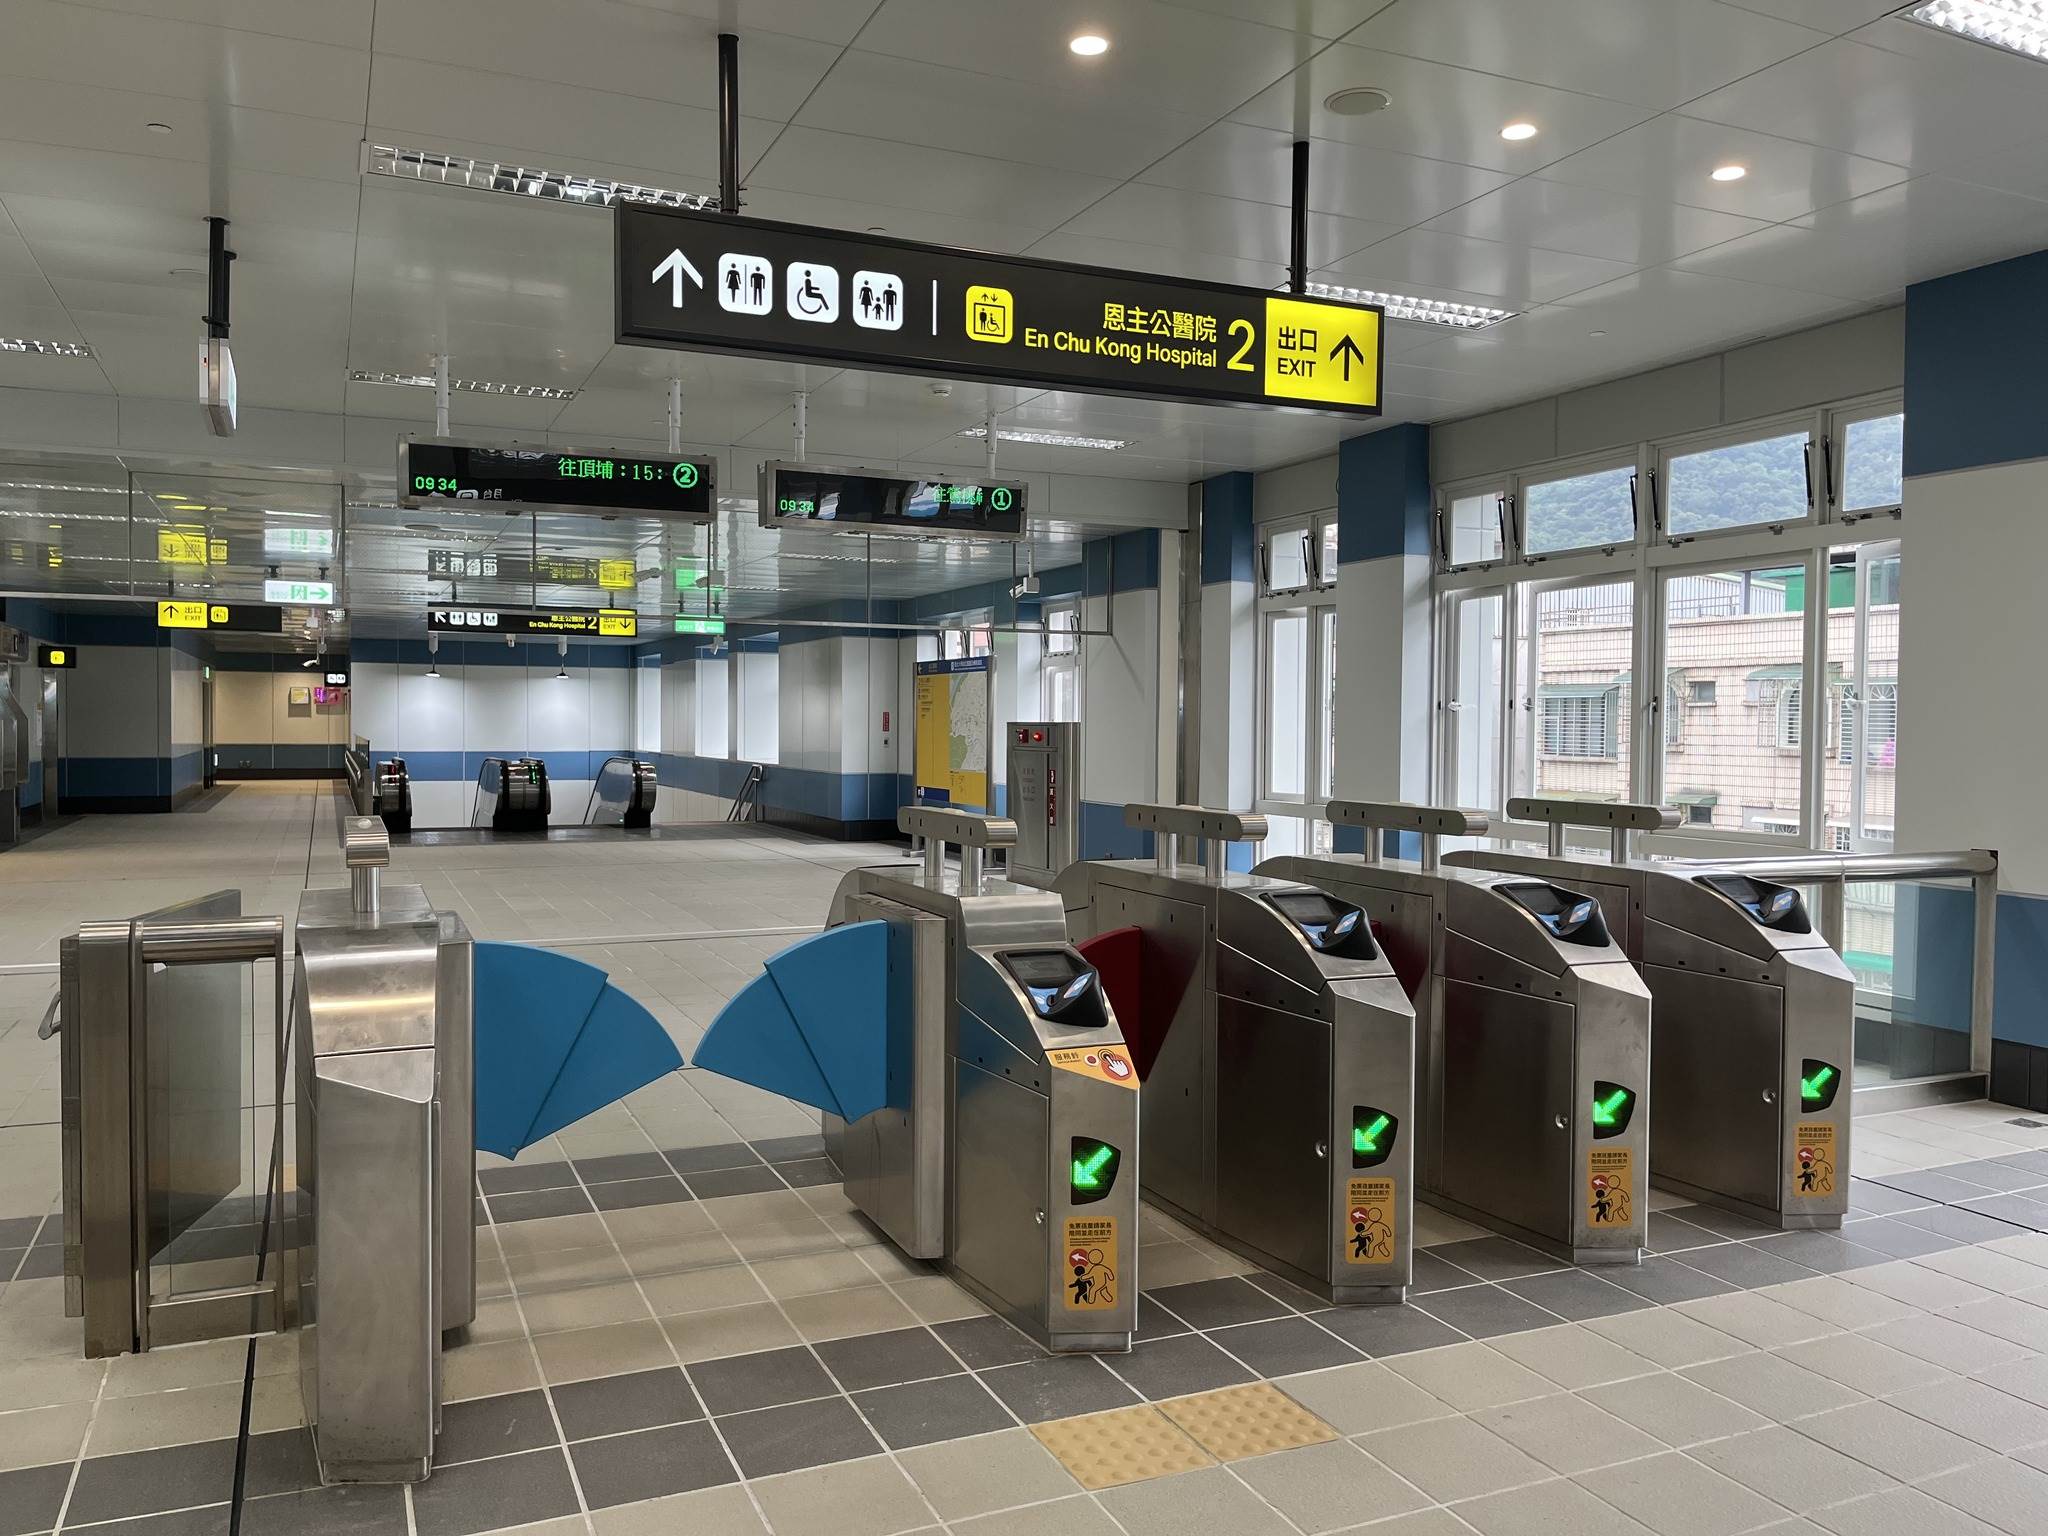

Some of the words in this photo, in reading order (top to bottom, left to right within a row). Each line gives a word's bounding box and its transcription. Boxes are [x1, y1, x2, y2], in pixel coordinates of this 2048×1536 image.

[1102, 302, 1217, 343] 恩主公醫院
[1277, 325, 1317, 353] 出口
[1024, 327, 1049, 347] En
[1054, 331, 1091, 353] Chu
[1095, 337, 1142, 364] Kong
[1146, 342, 1217, 369] Hospital
[1227, 318, 1255, 372] 2
[1277, 357, 1317, 378] EXIT
[587, 616, 598, 630] 2
